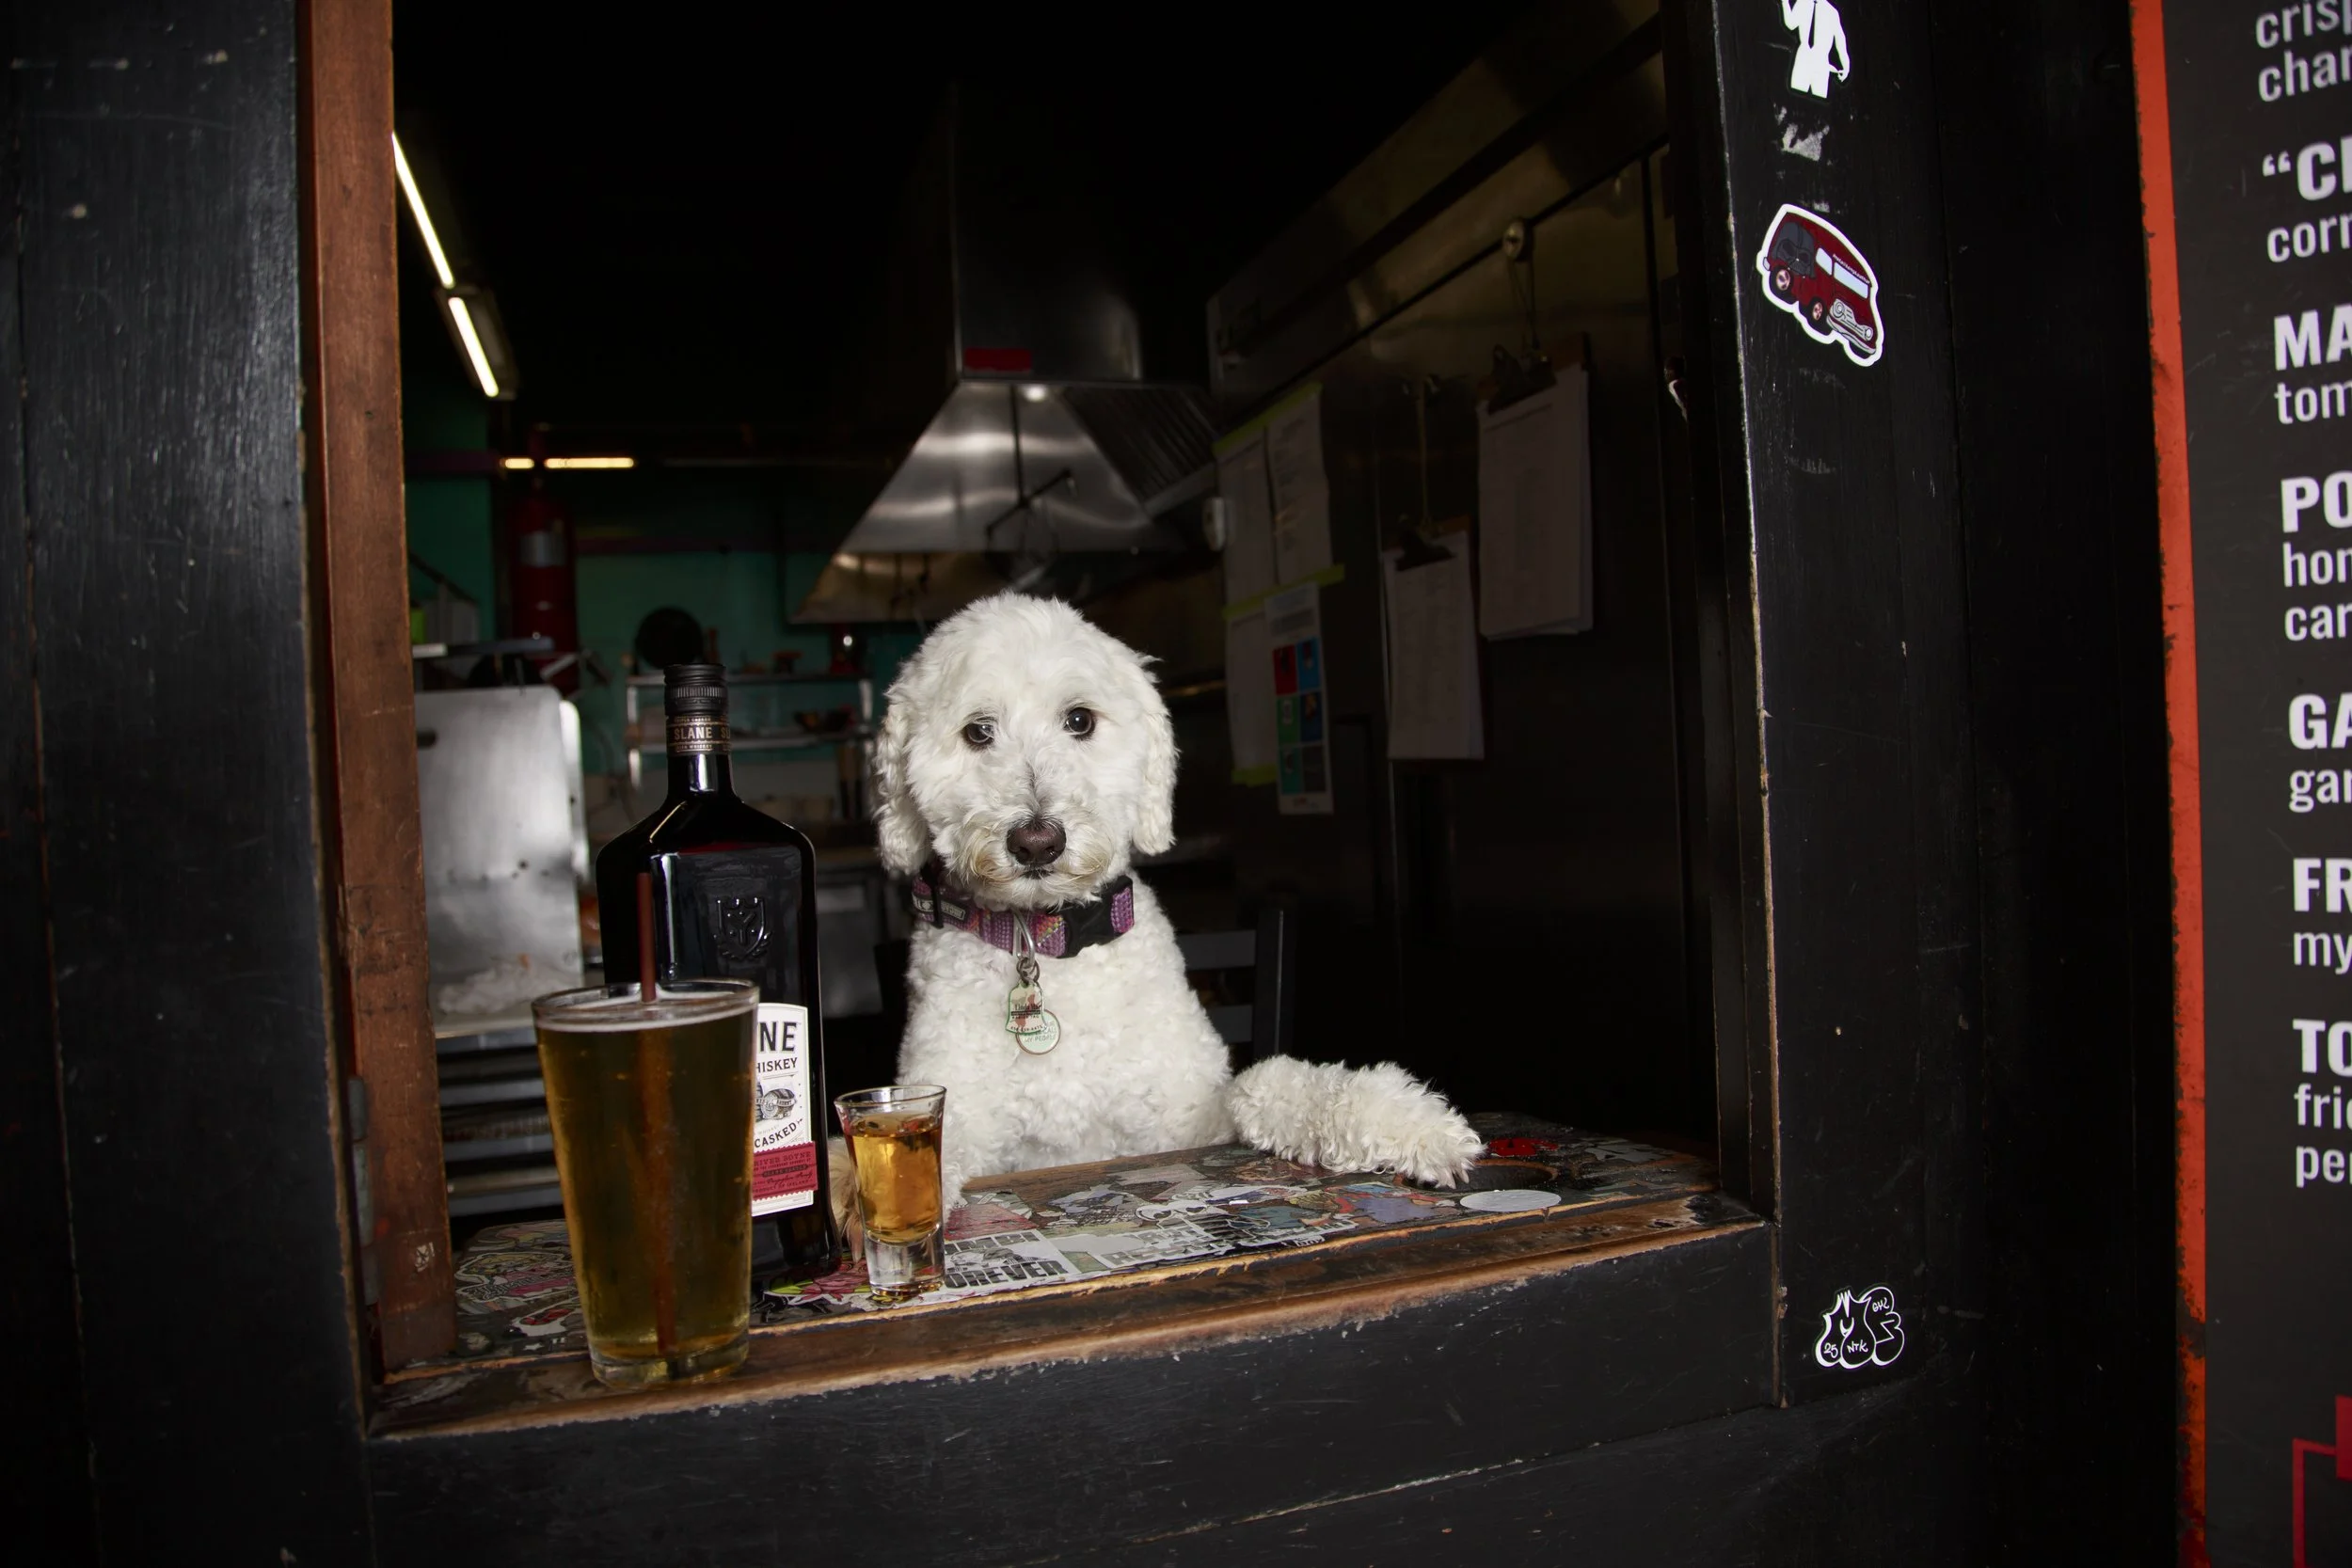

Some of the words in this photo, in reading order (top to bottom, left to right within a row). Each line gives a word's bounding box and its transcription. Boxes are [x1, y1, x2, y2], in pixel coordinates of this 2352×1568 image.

[2273, 302, 2352, 372] MA
[674, 726, 713, 740] SLANE
[2293, 857, 2352, 913] FR
[2294, 1083, 2352, 1132] fri
[755, 1122, 797, 1148] CASKED
[2296, 1144, 2352, 1189] pe
